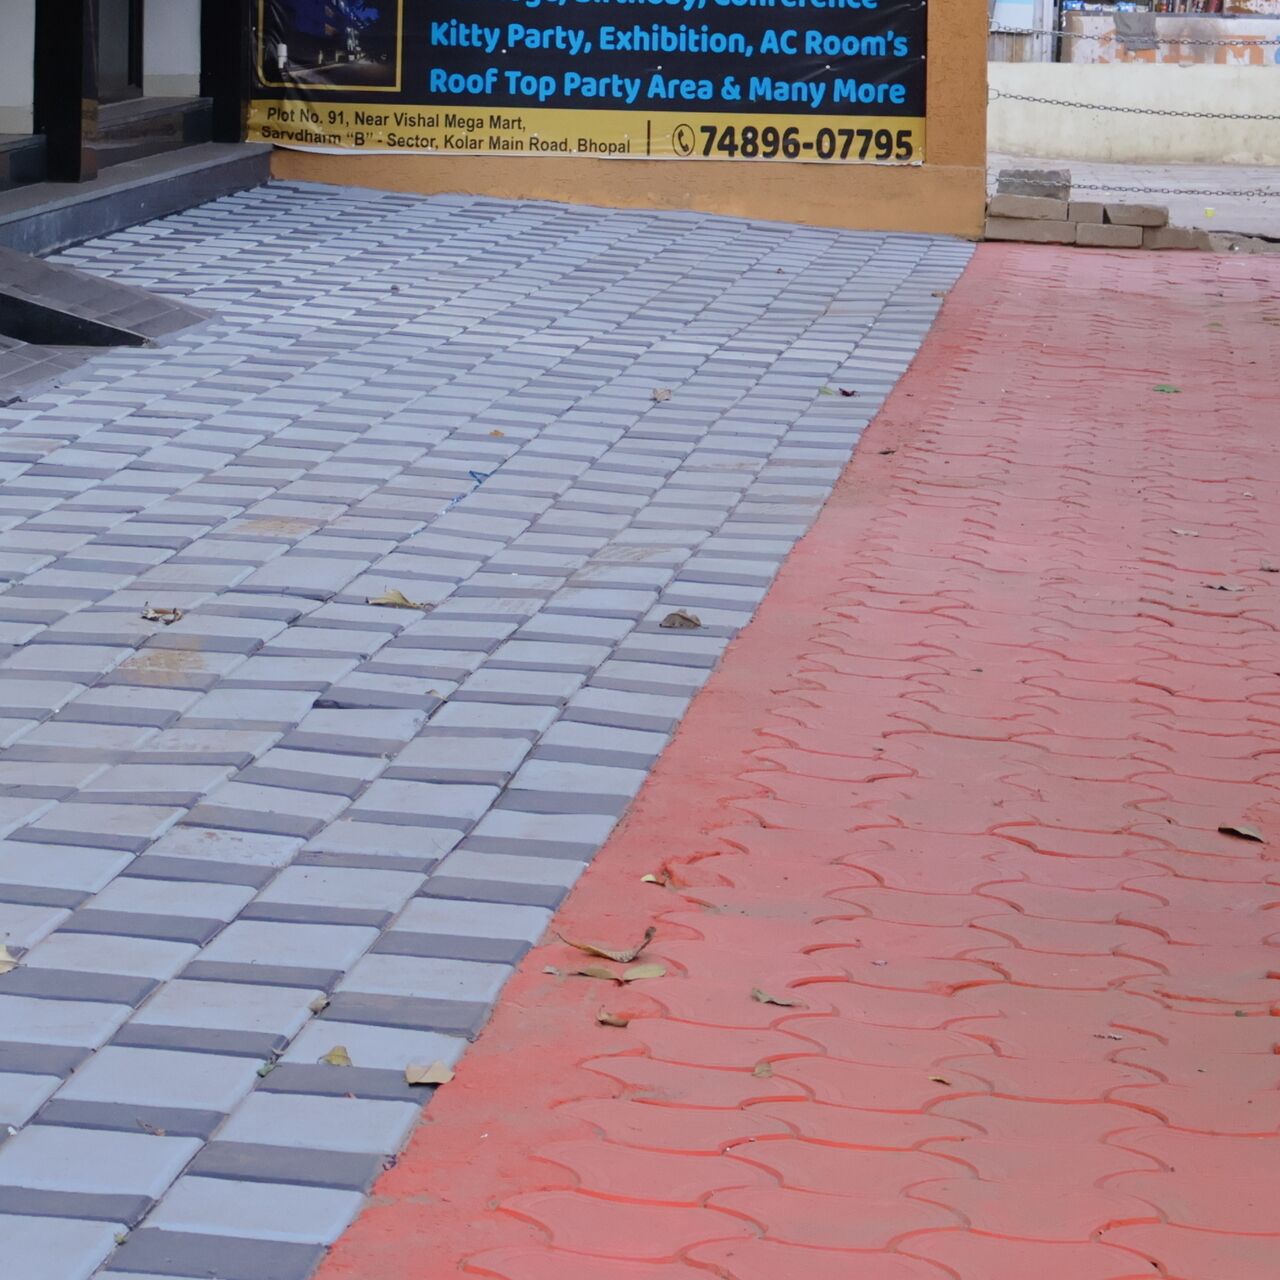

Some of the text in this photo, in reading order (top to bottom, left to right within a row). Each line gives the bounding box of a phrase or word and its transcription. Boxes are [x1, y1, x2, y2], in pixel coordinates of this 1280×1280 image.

[430, 19, 500, 53] Kitty
[507, 24, 592, 55] Party,
[599, 24, 754, 57] Exhibition,
[760, 29, 796, 55] AC
[429, 67, 906, 108] Roof Top Party Area & Many More
[267, 107, 526, 132] Plot No. 91, Near Vishal Mega Mart,
[387, 133, 439, 149] Sector,
[444, 134, 484, 149] Kolar
[489, 136, 524, 150] Main
[529, 137, 572, 152] Road,
[578, 138, 630, 155] Bhopal
[700, 124, 914, 160] 74896-07795
